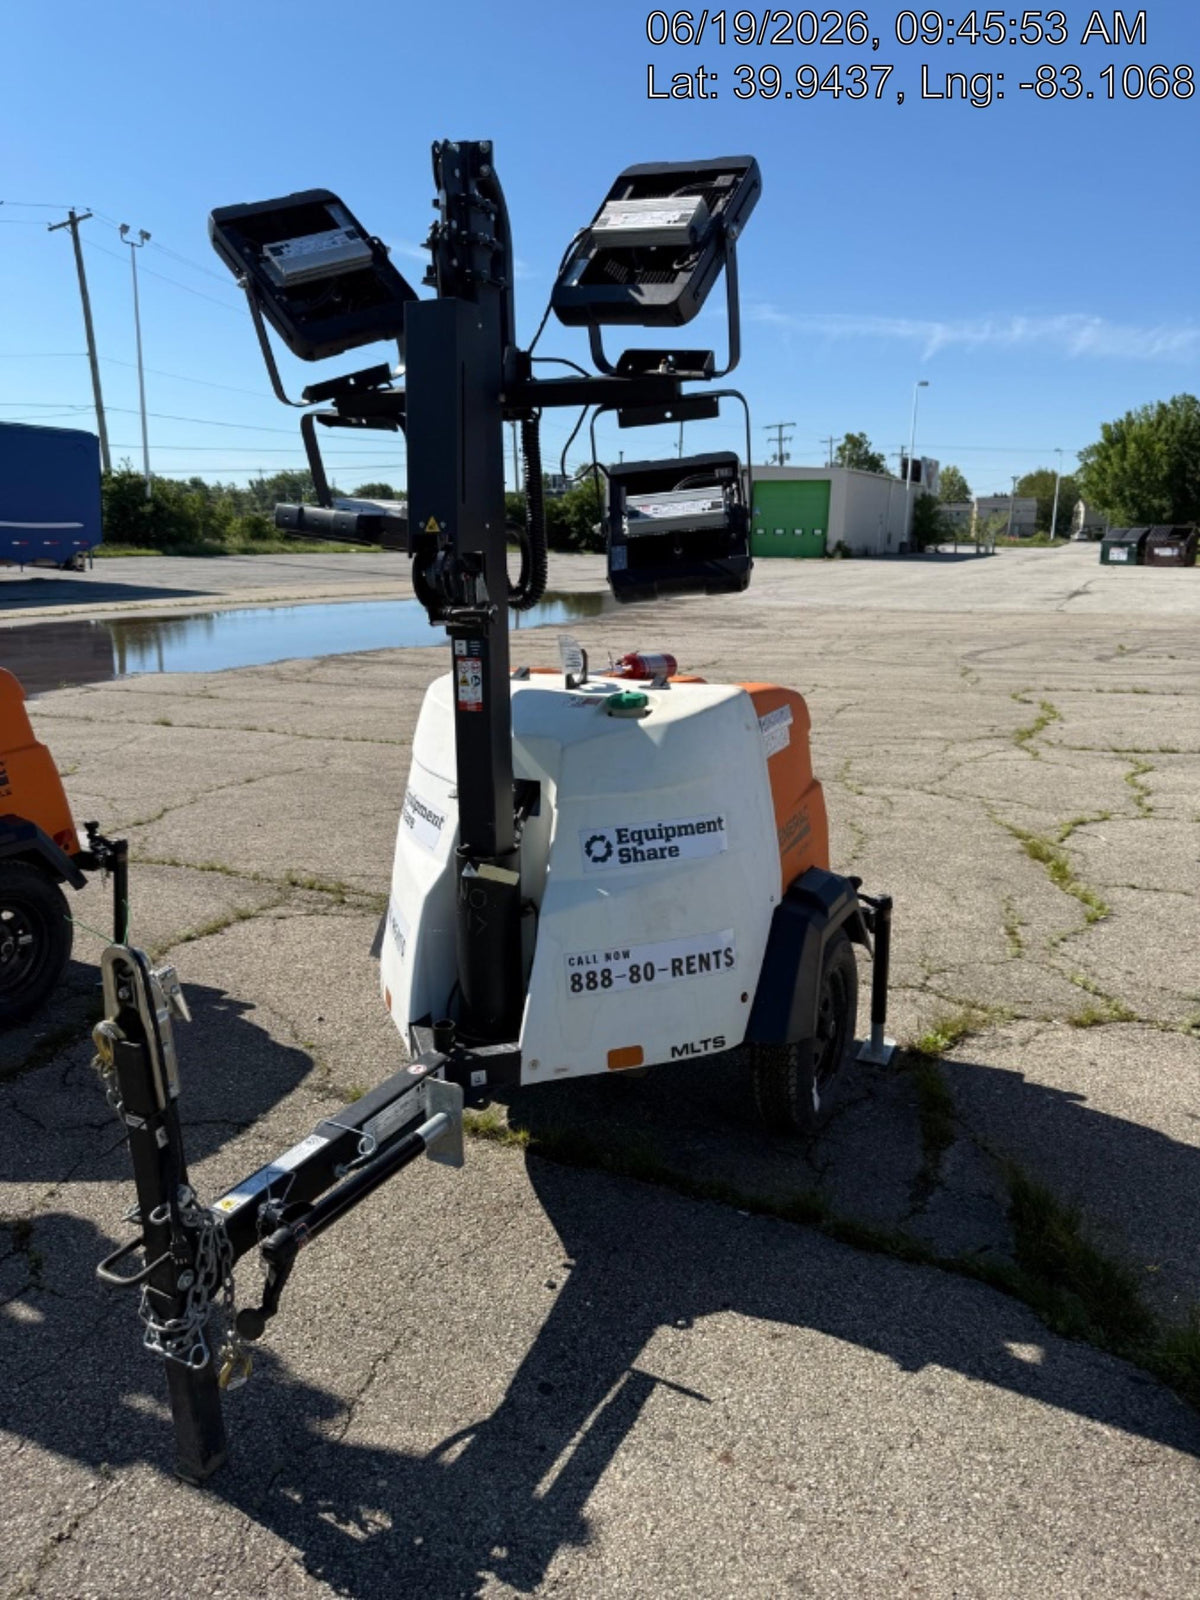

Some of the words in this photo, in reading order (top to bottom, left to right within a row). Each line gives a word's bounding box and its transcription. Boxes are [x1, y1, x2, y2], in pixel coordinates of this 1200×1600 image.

[615, 816, 724, 844] Equipment
[618, 844, 679, 863] Share
[568, 953, 600, 967] CALL
[604, 949, 632, 962] NOW
[570, 948, 735, 992] 888-80-RENTS
[671, 1035, 727, 1058] MLTS
